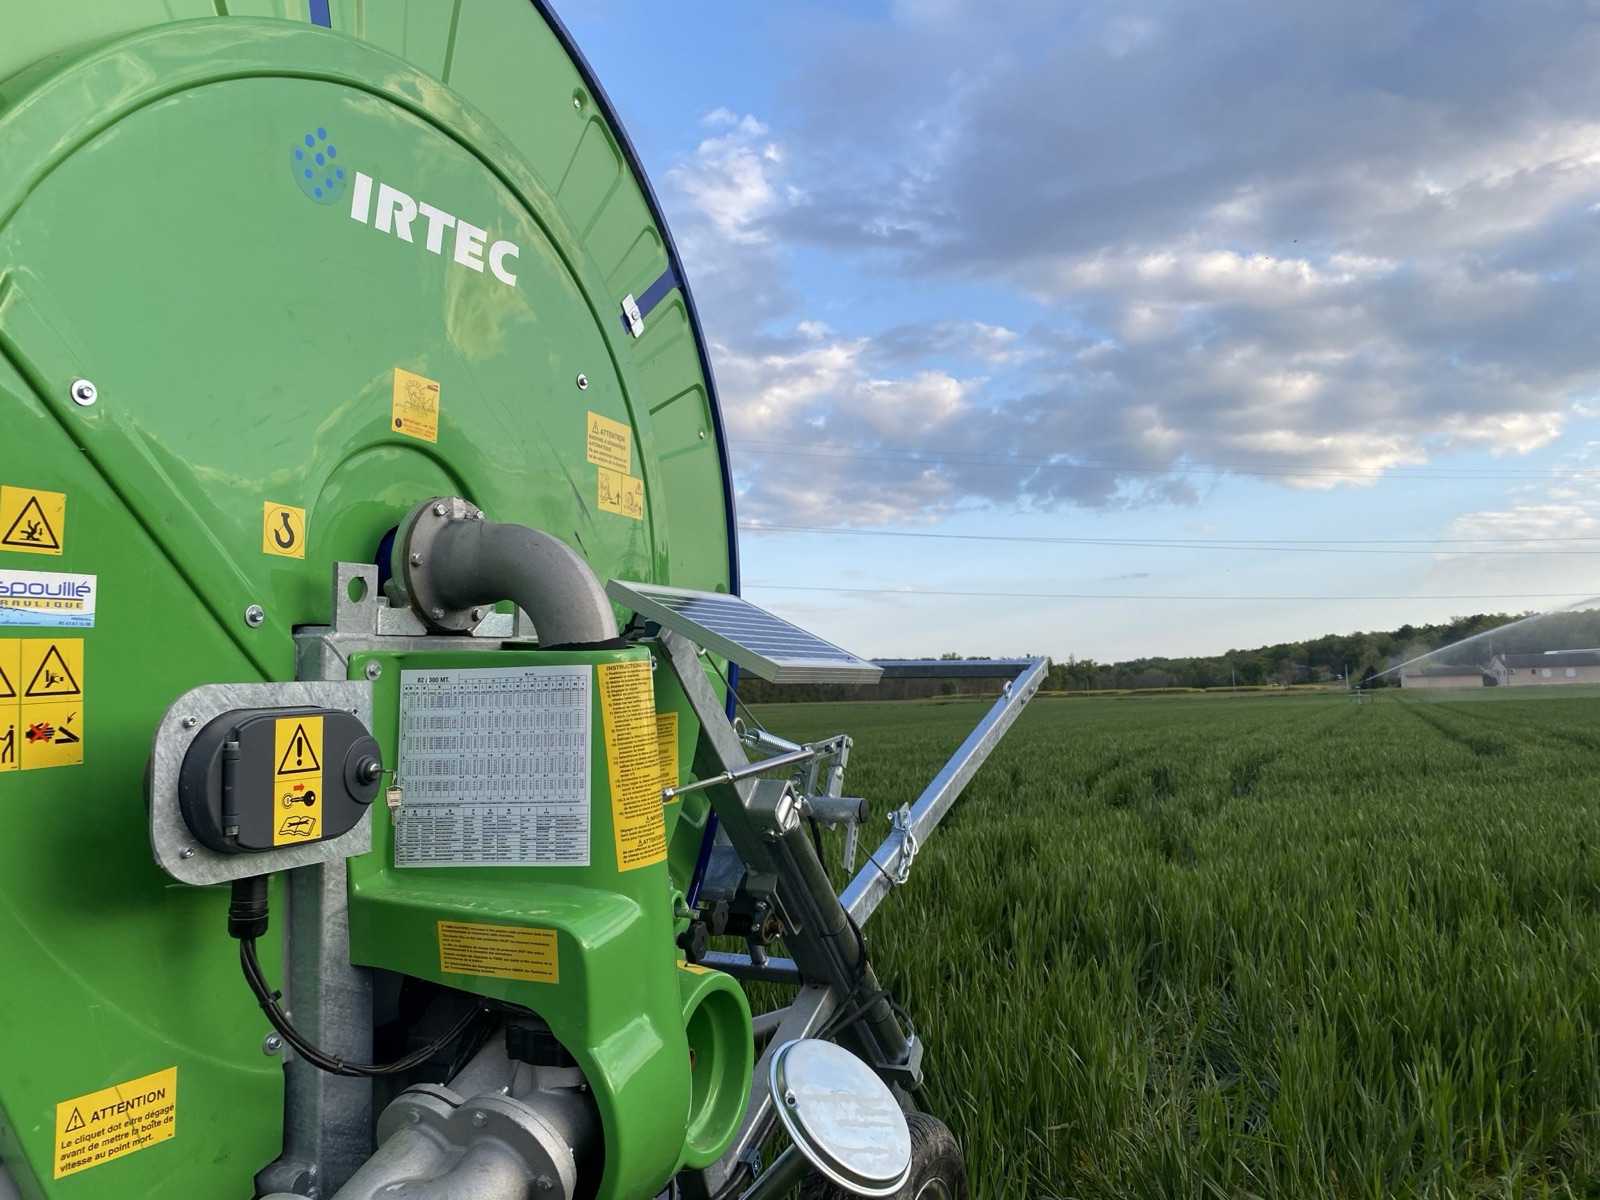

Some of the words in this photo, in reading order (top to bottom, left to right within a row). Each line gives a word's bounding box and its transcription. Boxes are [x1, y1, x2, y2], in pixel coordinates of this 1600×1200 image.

[350, 171, 519, 286] IRTEC
[600, 429, 625, 442] ATTENTION
[0, 600, 83, 608] RAULIQUE
[90, 1088, 166, 1123] ATTENTION
[60, 1146, 85, 1161] avant
[88, 1142, 99, 1152] de
[102, 1131, 129, 1146] mettre
[141, 1120, 161, 1132] boîte
[164, 1116, 173, 1124] de
[61, 1140, 72, 1149] Le
[74, 1129, 105, 1145] cliquet
[107, 1123, 121, 1133] dot
[144, 1103, 174, 1120] dégagé
[60, 1156, 92, 1172] vitesse
[95, 1152, 106, 1161] au
[108, 1142, 130, 1157] point
[132, 1134, 153, 1146] mort.
